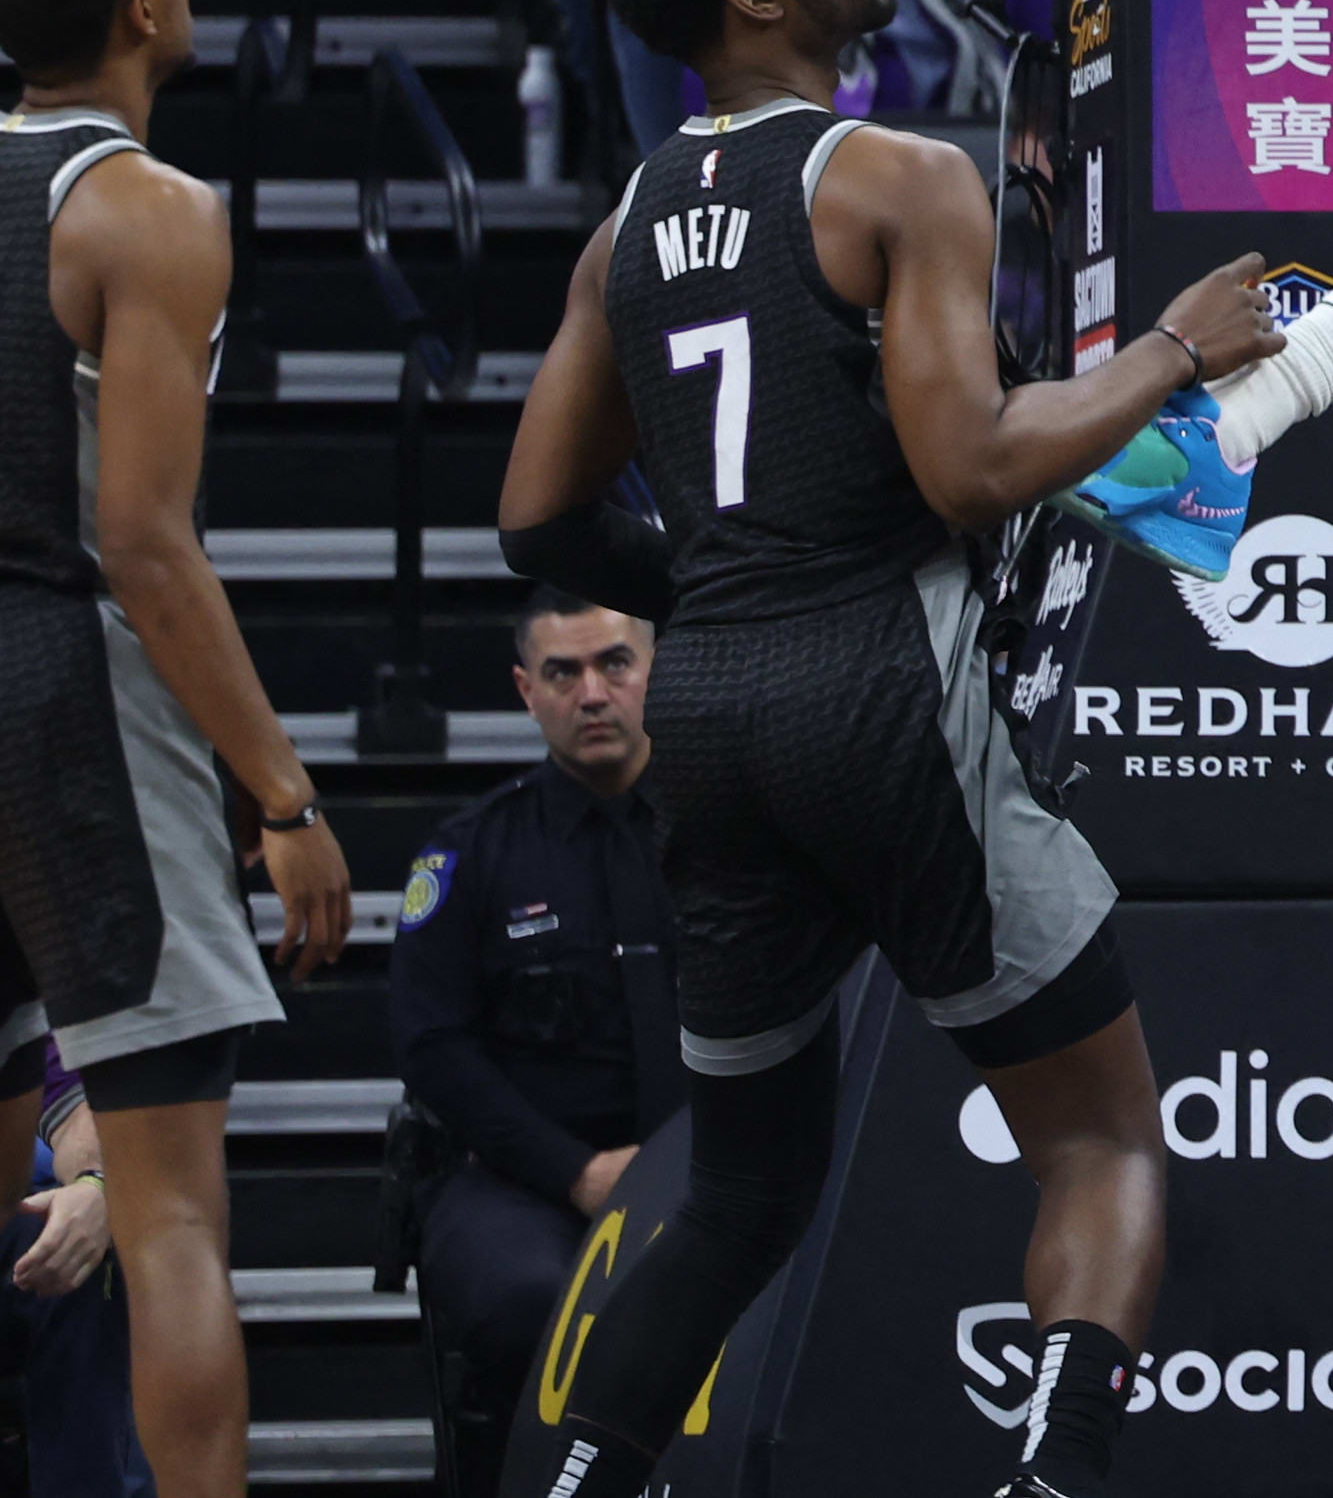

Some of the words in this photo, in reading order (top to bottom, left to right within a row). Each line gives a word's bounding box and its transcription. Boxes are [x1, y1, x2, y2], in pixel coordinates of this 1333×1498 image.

[1070, 53, 1112, 99] CALIFORNIA
[653, 204, 751, 282] METU
[1257, 282, 1325, 318] BLU
[665, 313, 752, 510] 7
[1125, 756, 1272, 777] RESORT
